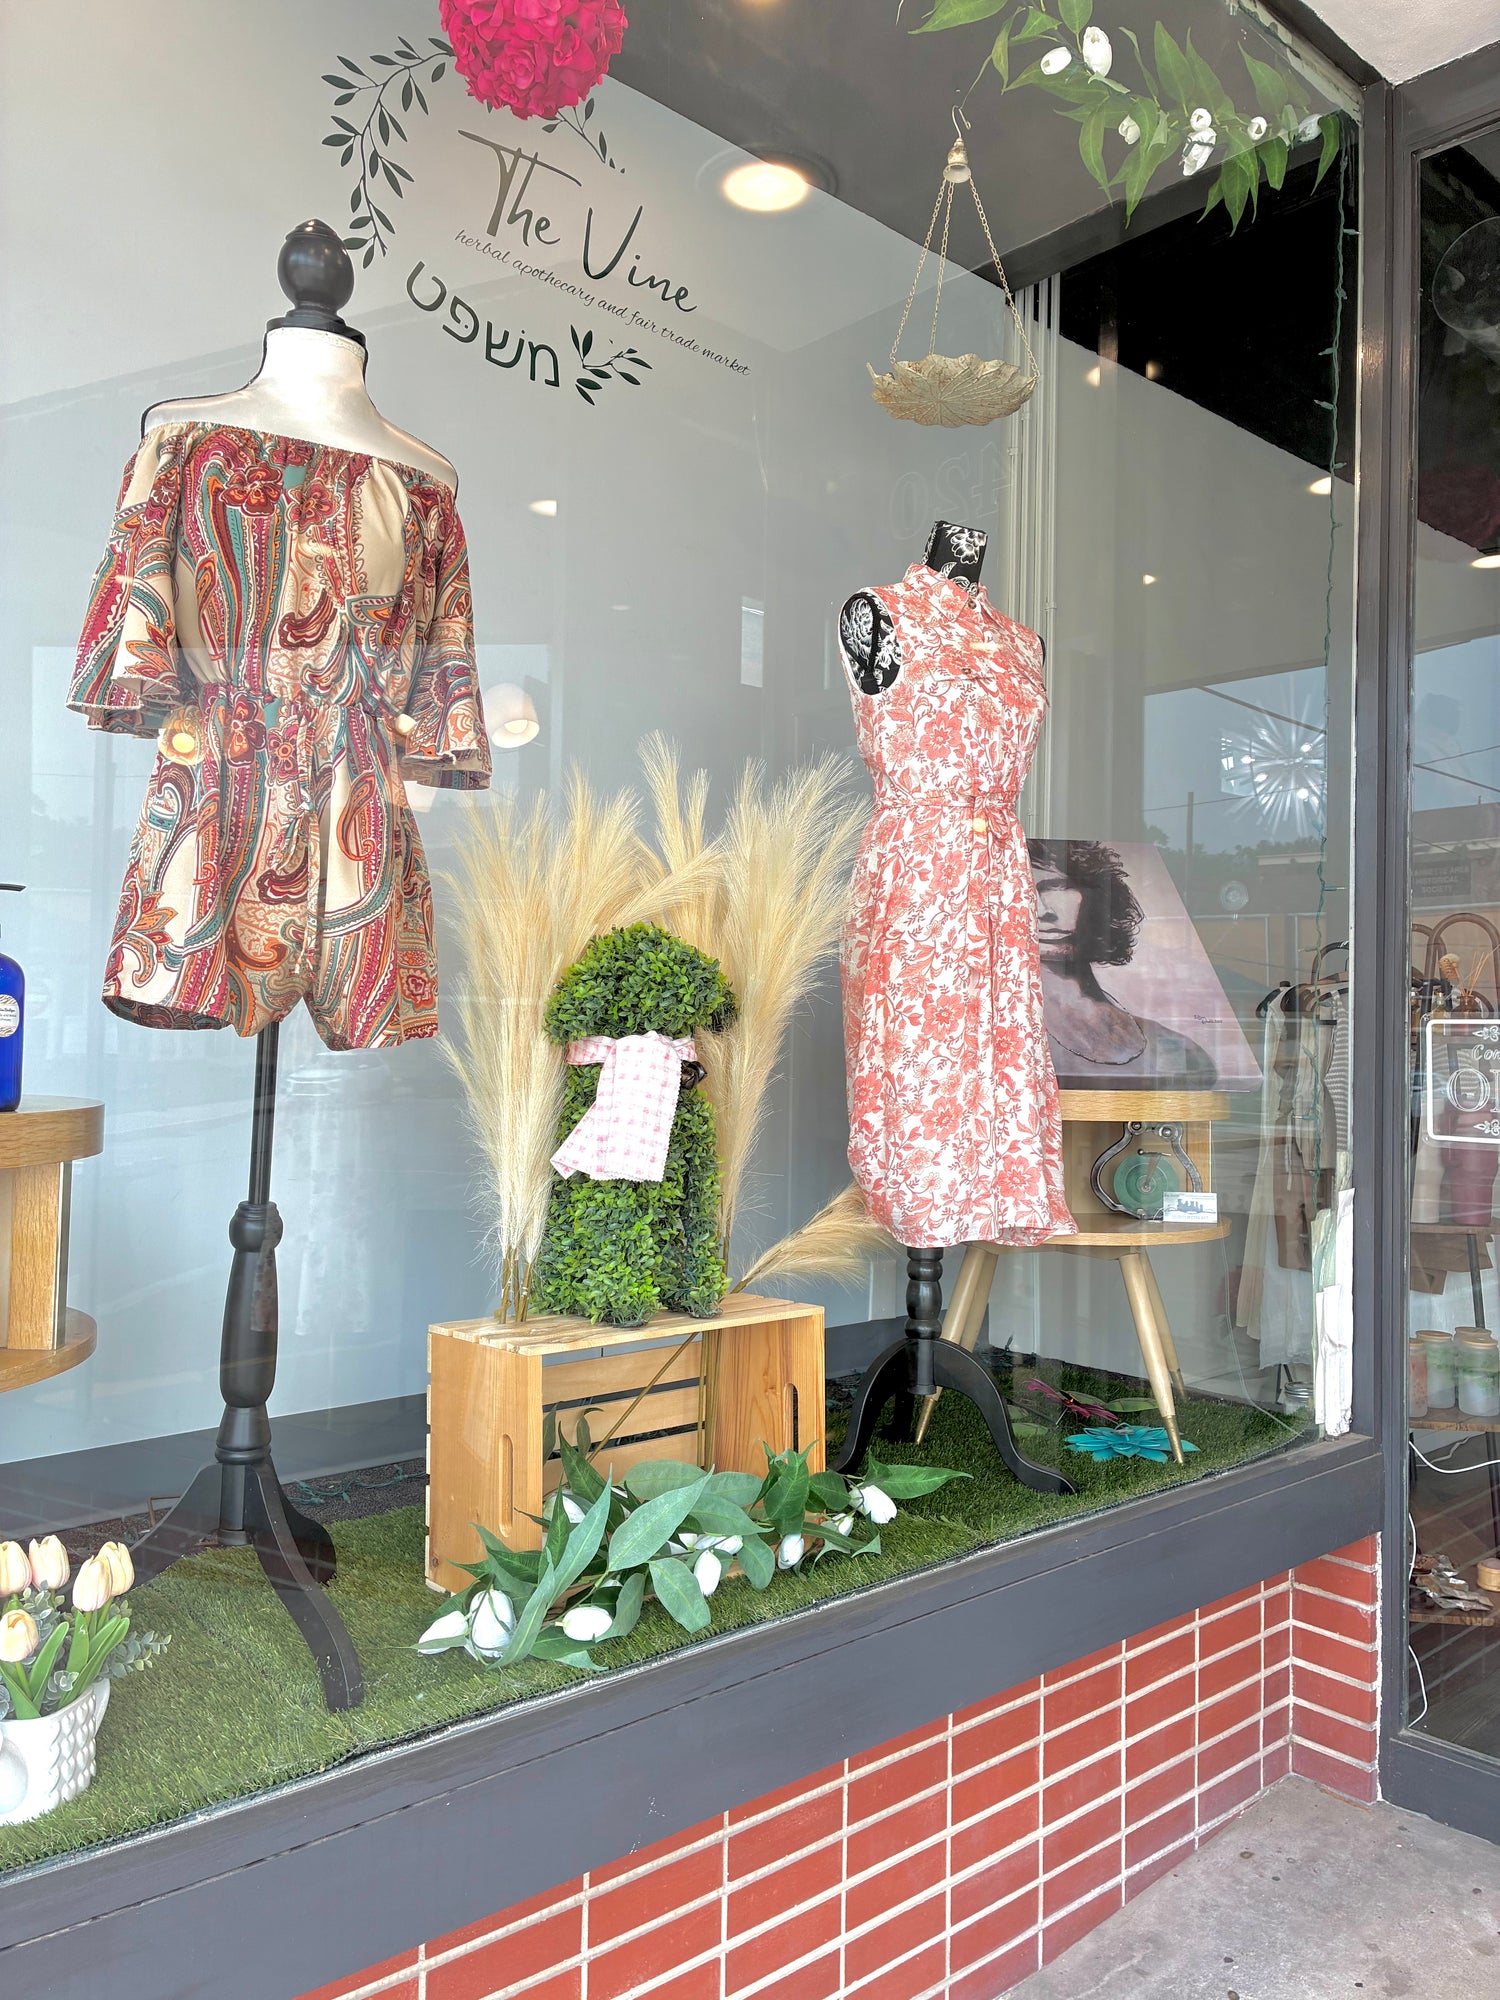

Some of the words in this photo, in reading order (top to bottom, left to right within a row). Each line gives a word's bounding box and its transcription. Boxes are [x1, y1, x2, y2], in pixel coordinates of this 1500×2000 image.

[454, 229, 511, 263] herbal
[512, 260, 596, 307] apothecary
[597, 299, 628, 318] and
[625, 311, 659, 333] fair
[661, 327, 701, 352] trade
[702, 347, 751, 376] market
[458, 129, 581, 248] The
[583, 205, 697, 312] Vine
